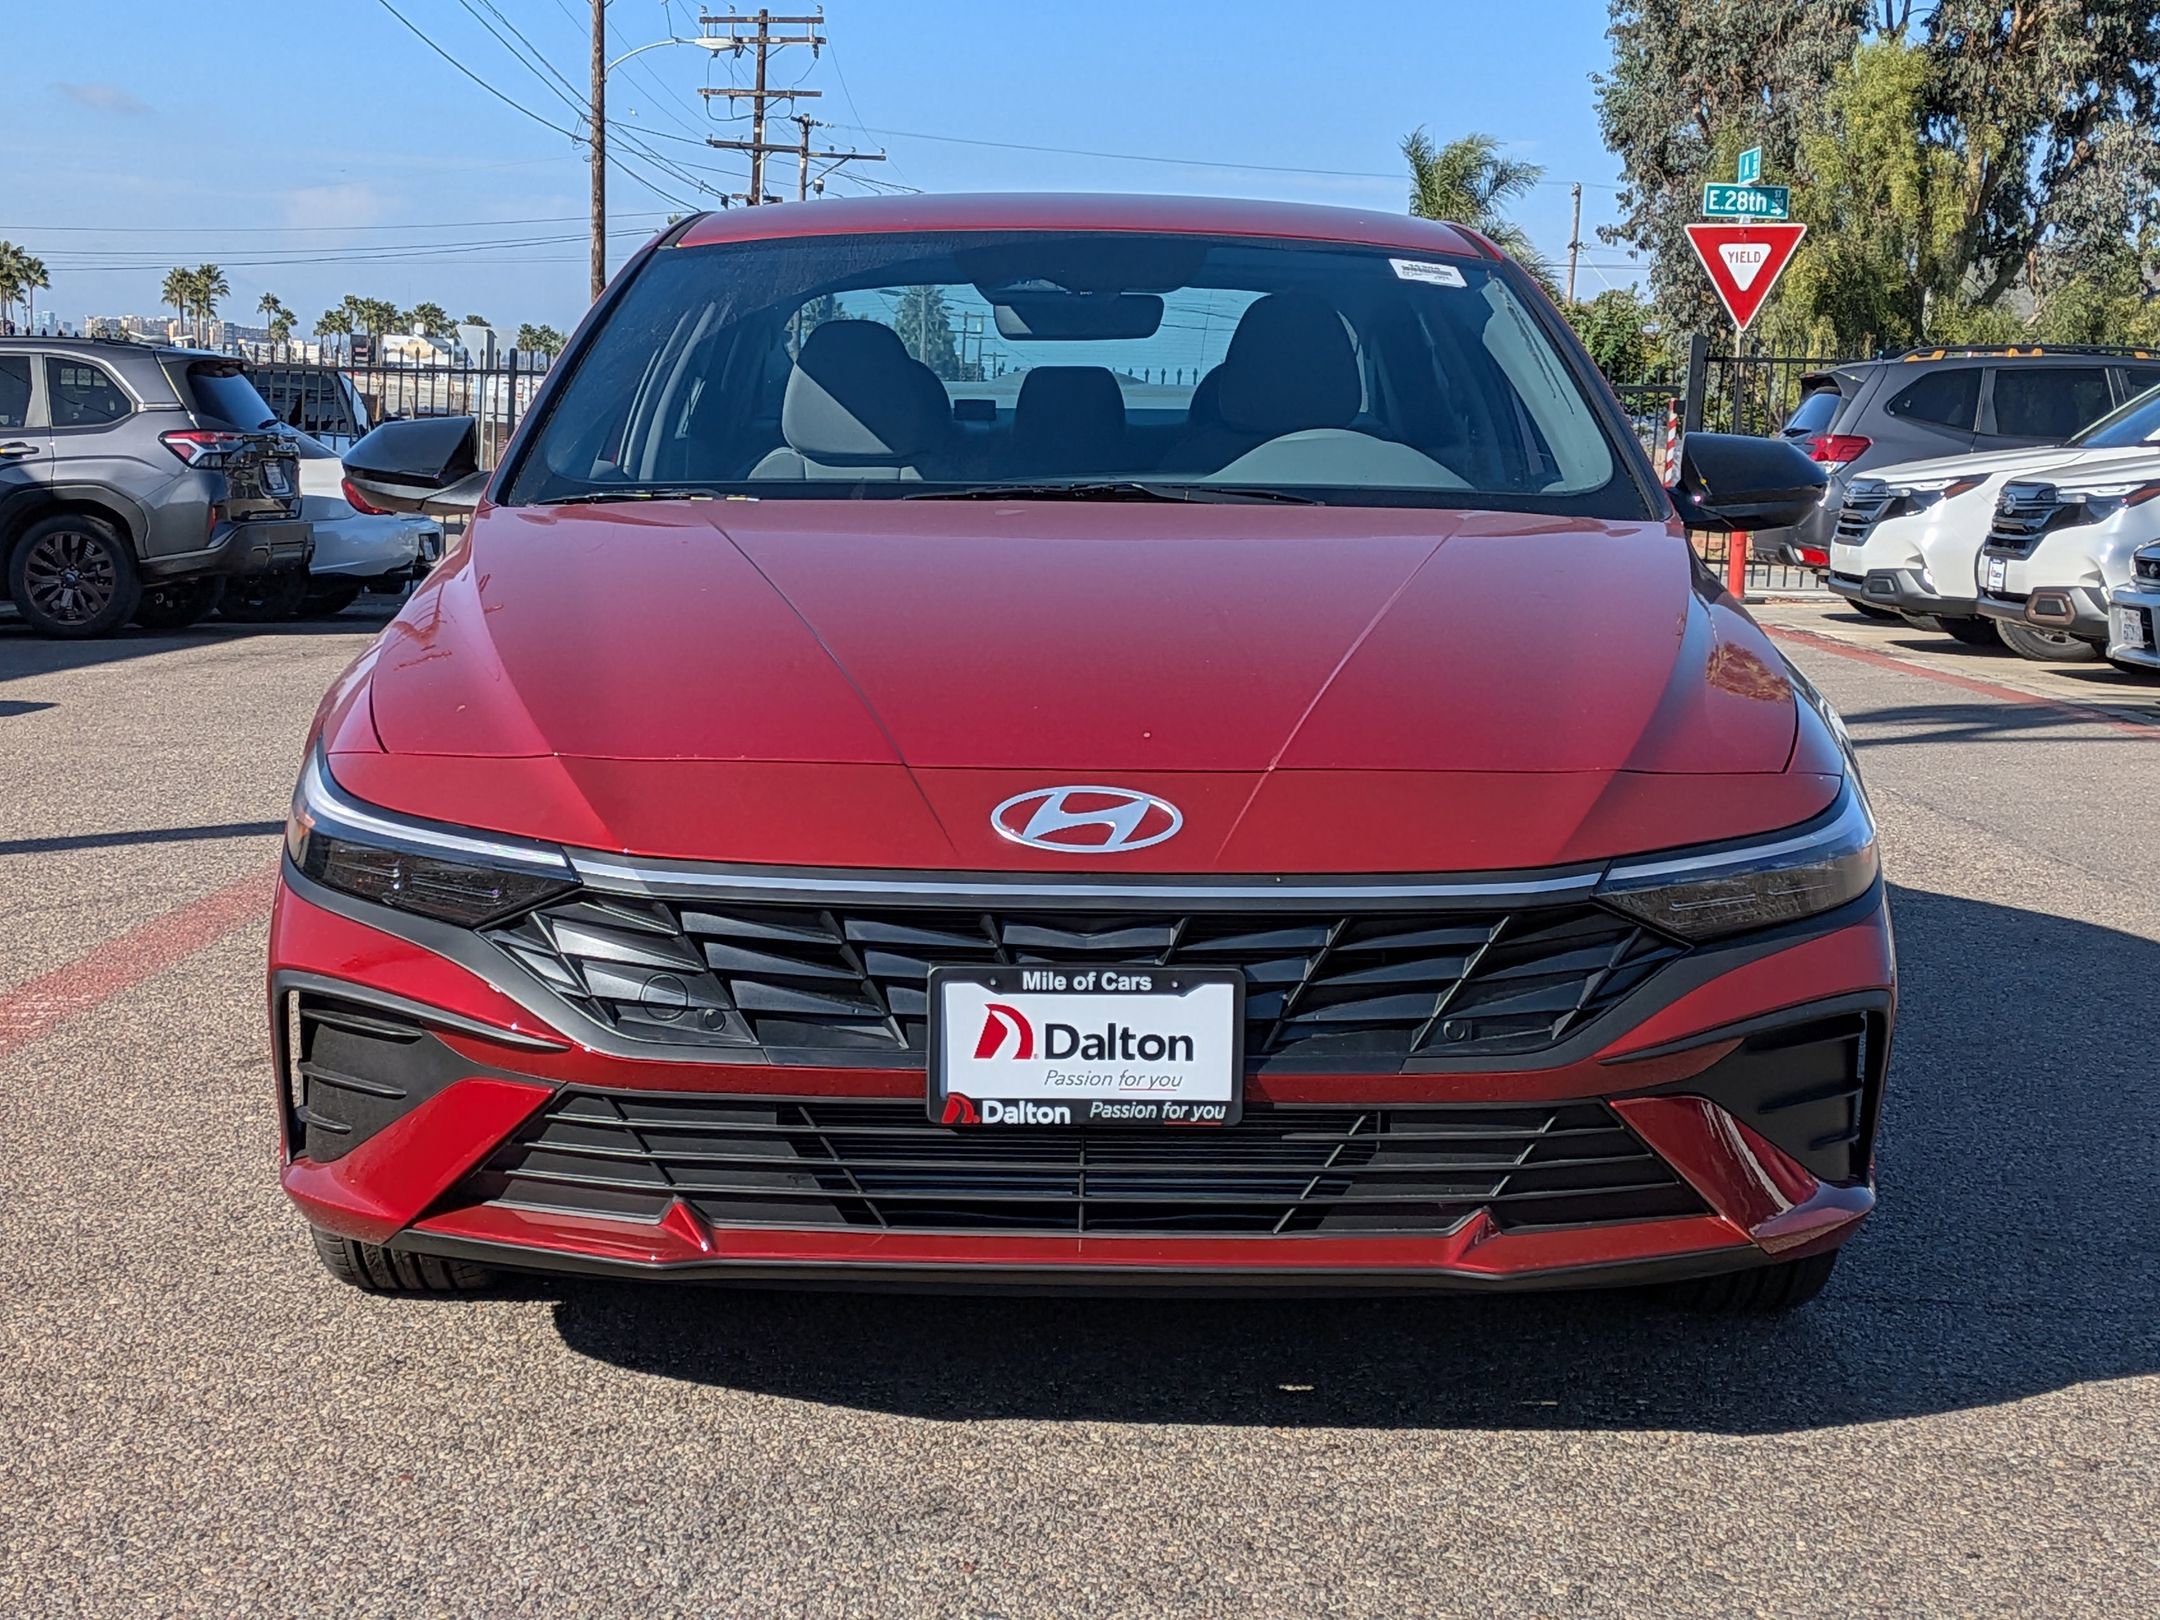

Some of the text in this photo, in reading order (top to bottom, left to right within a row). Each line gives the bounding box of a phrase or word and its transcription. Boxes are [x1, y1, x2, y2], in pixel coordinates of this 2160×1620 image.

[1708, 190, 1767, 212] E.28th
[1727, 251, 1761, 263] YIELD
[1022, 971, 1152, 991] Mile of Cars
[1045, 1023, 1194, 1061] Dalton
[1044, 1069, 1183, 1090] Passion for you
[981, 1100, 1227, 1124] Dalton Passion for you
